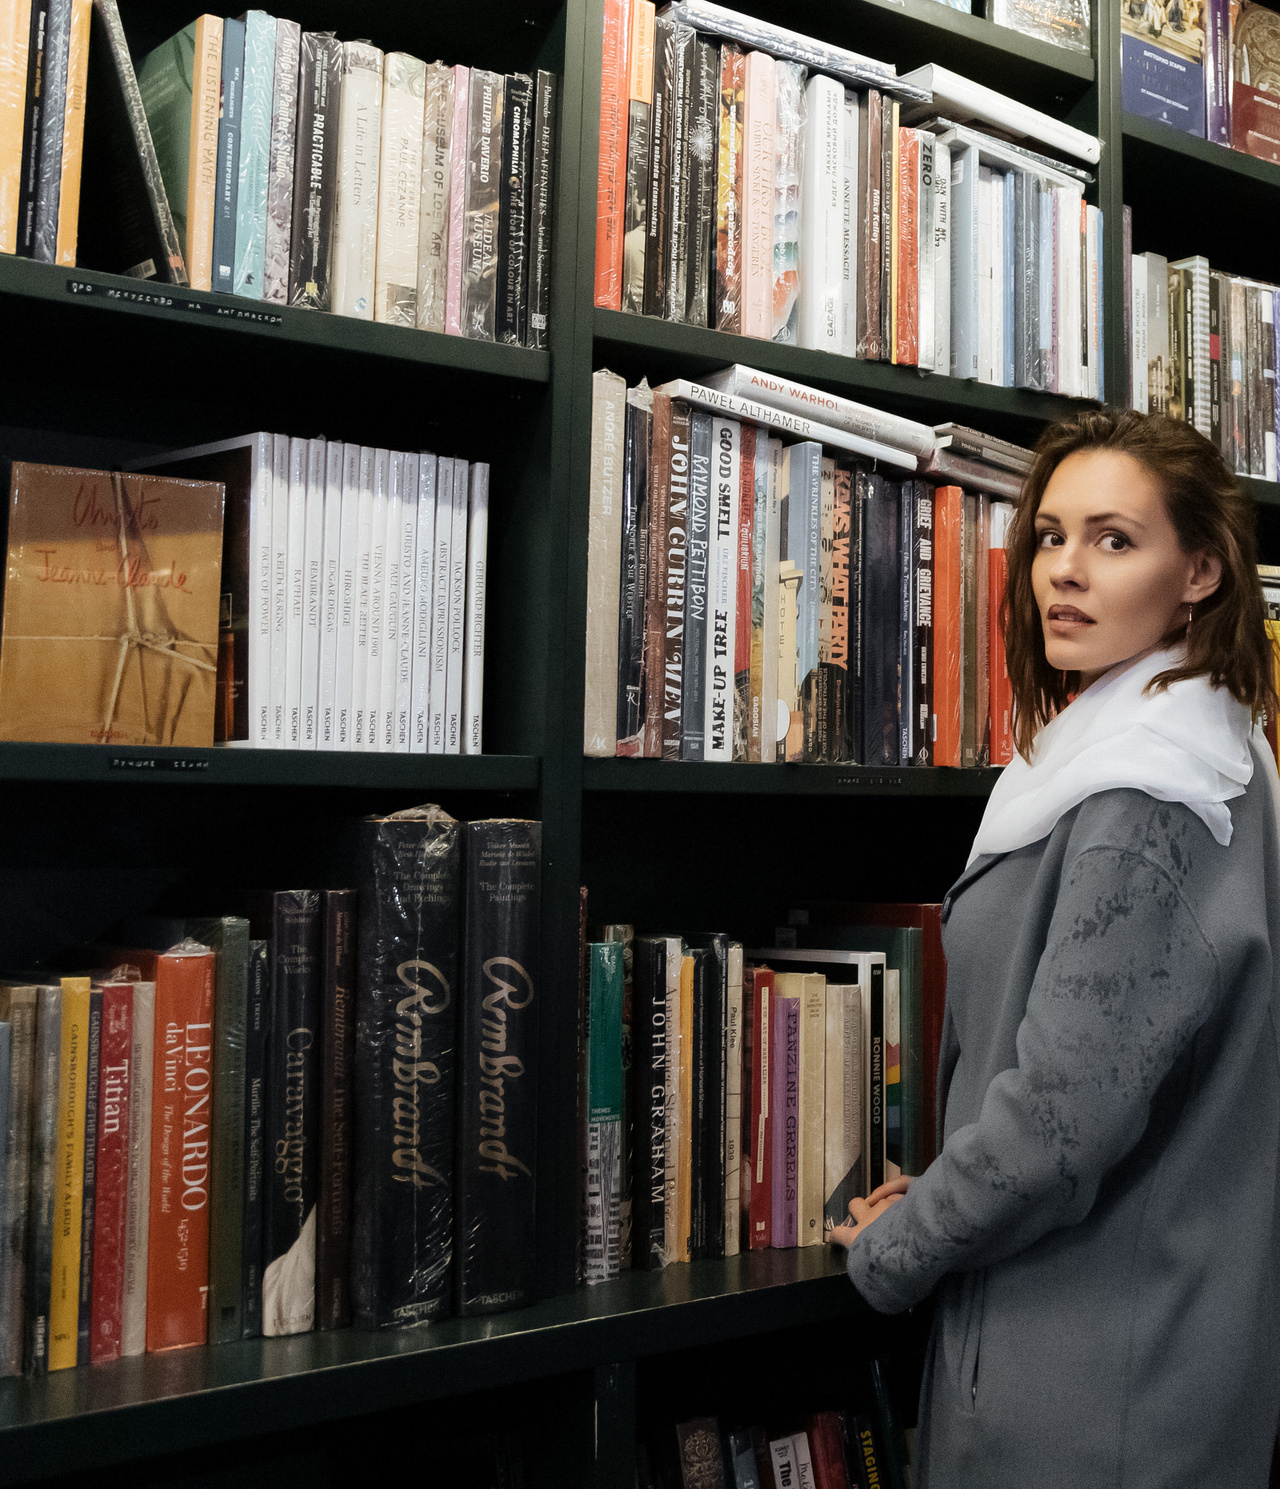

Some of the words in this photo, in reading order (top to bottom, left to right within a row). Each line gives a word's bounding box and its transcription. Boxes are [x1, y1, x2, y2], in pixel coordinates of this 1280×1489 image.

[207, 34, 219, 60] THE
[282, 37, 296, 71] Inside
[281, 72, 293, 90] the
[203, 67, 217, 141] LISTENING
[277, 95, 293, 140] Painter's
[357, 102, 367, 112] A
[481, 85, 492, 133] PHILIPPE
[355, 116, 367, 141] Life
[355, 145, 366, 156] in
[728, 105, 737, 185] модернизма
[201, 148, 213, 185] PATH
[277, 146, 290, 178] Studio
[310, 113, 324, 189] PRACTICABLE
[480, 136, 491, 183] DAVERIO
[922, 142, 932, 186] ZERO
[353, 161, 365, 206] Letters
[872, 189, 881, 213] Mike
[472, 213, 483, 270] MUSEUM
[726, 191, 736, 276] Возрождение
[870, 214, 880, 243] Kelley
[690, 385, 736, 410] PAWEŁ
[738, 402, 811, 434] ALTHAMER
[750, 375, 785, 394] ANDY
[789, 386, 842, 412] WARHOL
[604, 401, 616, 453] ANDRÉ
[669, 436, 689, 514] JOHN
[718, 428, 732, 479] GOOD
[810, 454, 819, 475] THE
[602, 456, 615, 516] BUTZER
[692, 454, 709, 533] RAYMOND
[754, 491, 763, 520] GAZING
[810, 478, 819, 530] WRINKLES
[831, 469, 850, 535] KAWS
[716, 482, 731, 541] SMELL
[754, 522, 763, 542] BALL
[919, 499, 931, 529] GRIEF
[403, 523, 413, 568] CHRISTO
[721, 546, 729, 565] URS
[809, 543, 818, 565] THE
[810, 532, 818, 542] OF
[919, 539, 931, 560] AND
[261, 546, 270, 579] FACES
[276, 552, 285, 585] KEITH
[327, 559, 336, 596] EDGAR
[361, 552, 369, 573] THE
[373, 544, 382, 585] VIENNA
[390, 563, 398, 588] PAUL
[403, 571, 412, 595] AND
[419, 548, 429, 593] AMEDEO
[438, 540, 448, 592] ABSTRACT
[453, 561, 462, 604] JACKSON
[666, 527, 687, 639] CURRIN
[690, 541, 708, 620] PETTIBON
[754, 544, 763, 586] PAINTINGS
[809, 567, 817, 593] CITY
[831, 537, 849, 603] WHAT
[261, 581, 269, 593] OF
[293, 569, 302, 619] RAPHAEL
[308, 560, 318, 628] REMBRANDT
[343, 570, 352, 626] HIROSHIGE
[360, 575, 368, 609] BLAUE
[474, 561, 483, 610] GERHARD
[720, 568, 728, 604] FISCHER
[919, 568, 932, 627] GRIEVANCE
[260, 596, 269, 635] POWER
[275, 588, 285, 632] HARING
[326, 598, 336, 633] DEGAS
[358, 610, 367, 647] REITER
[371, 588, 381, 633] AROUND
[389, 591, 398, 640] GAUGUIN
[417, 595, 428, 658] MODIGLIANI
[451, 607, 461, 654] POLLOCK
[371, 636, 379, 657] 1900
[400, 599, 411, 683] JEANNE-CLAUDE
[435, 594, 446, 672] EXPRESSIONISM
[473, 613, 483, 657] RICHTER
[713, 610, 729, 660] TREE
[831, 606, 848, 671] PARTY
[664, 652, 683, 723] MEN
[712, 665, 728, 750] MAKE-UP
[291, 707, 299, 741] TASCHEN
[306, 706, 314, 740] TASCHEN
[385, 711, 393, 744] TASCHEN
[333, 985, 352, 1080] Rembrandt
[652, 997, 666, 1069] JOHN
[729, 1027, 737, 1049] Klee
[87, 1011, 100, 1099] GAINSBOROUGH
[391, 960, 451, 1191] Rembrandt
[478, 956, 534, 1182] Rembrandt
[786, 1012, 798, 1108] FANZINE
[873, 1037, 881, 1082] RONNIE
[64, 1024, 79, 1140] GAINSBOROUGH'S
[103, 1059, 129, 1134] Titian
[333, 1087, 348, 1112] The
[86, 1113, 97, 1132] THE
[87, 1101, 98, 1111] &
[163, 1104, 174, 1120] The
[181, 1021, 211, 1210] LEONARDO
[275, 1028, 314, 1202] Caravaggio
[873, 1085, 881, 1124] WOOD
[161, 1123, 173, 1152] Design
[651, 1086, 665, 1203] GRAHAM
[727, 1139, 735, 1160] 1939
[785, 1115, 796, 1201] GRRRLS
[63, 1143, 75, 1189] FAMILY
[85, 1135, 97, 1185] THEATRE
[162, 1155, 173, 1165] of
[162, 1168, 172, 1183] the
[331, 1115, 347, 1236] Self-Portraits
[62, 1193, 74, 1237] ALBUM
[161, 1187, 171, 1213] World
[36, 1315, 46, 1356] HIRMER
[779, 1461, 791, 1487] The
